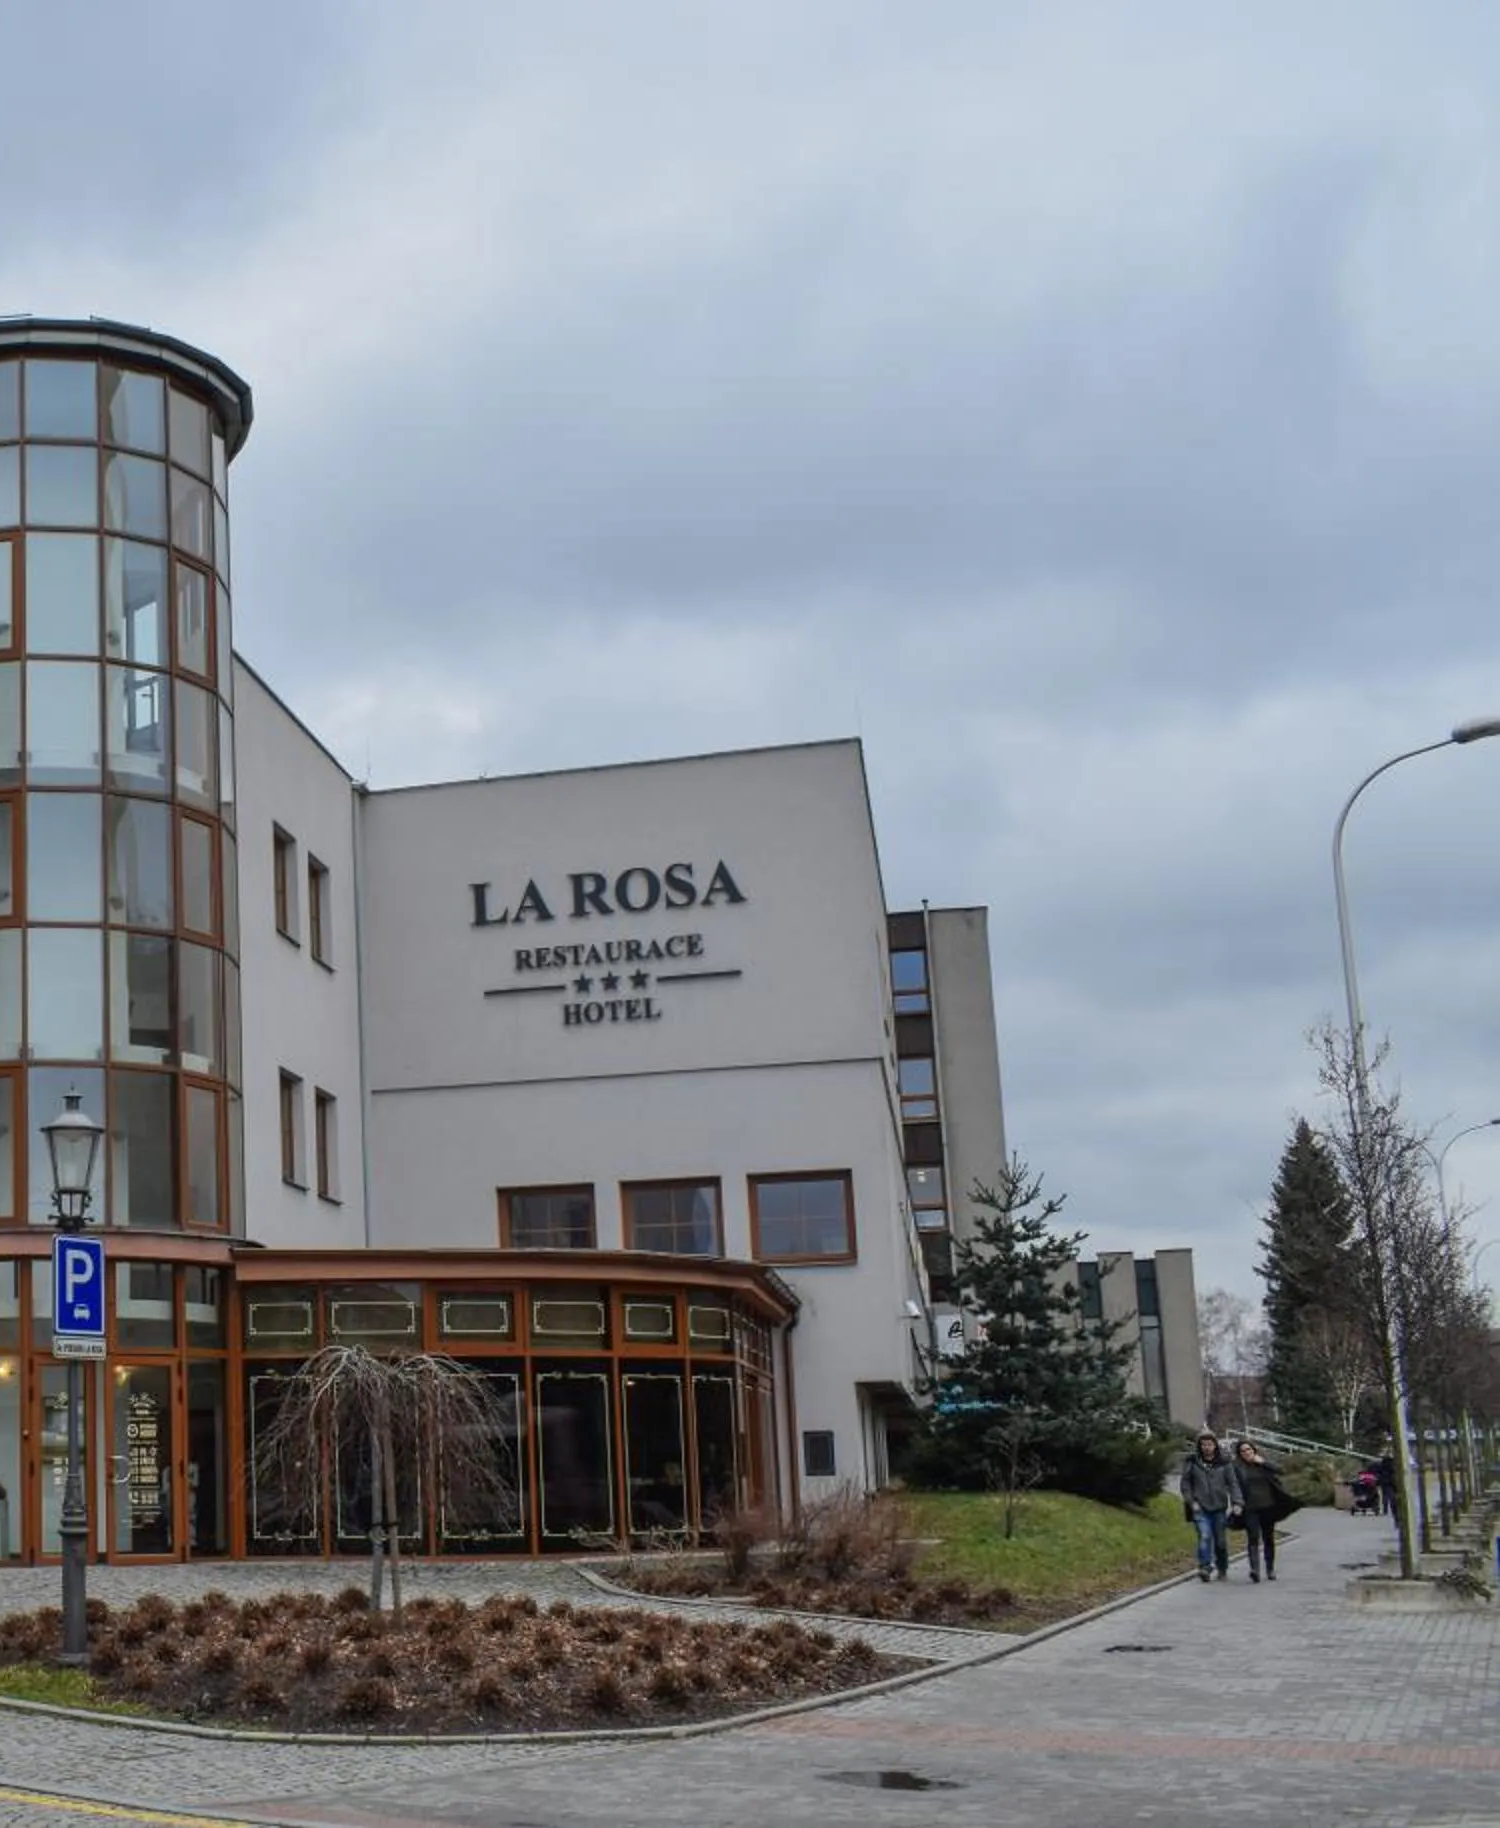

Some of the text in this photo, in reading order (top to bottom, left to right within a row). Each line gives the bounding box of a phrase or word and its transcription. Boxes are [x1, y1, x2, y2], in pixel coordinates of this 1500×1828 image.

[469, 860, 747, 928] LA ROSA
[514, 934, 704, 972] RESTAURACE
[562, 998, 662, 1027] HOTEL
[65, 1249, 94, 1303] P
